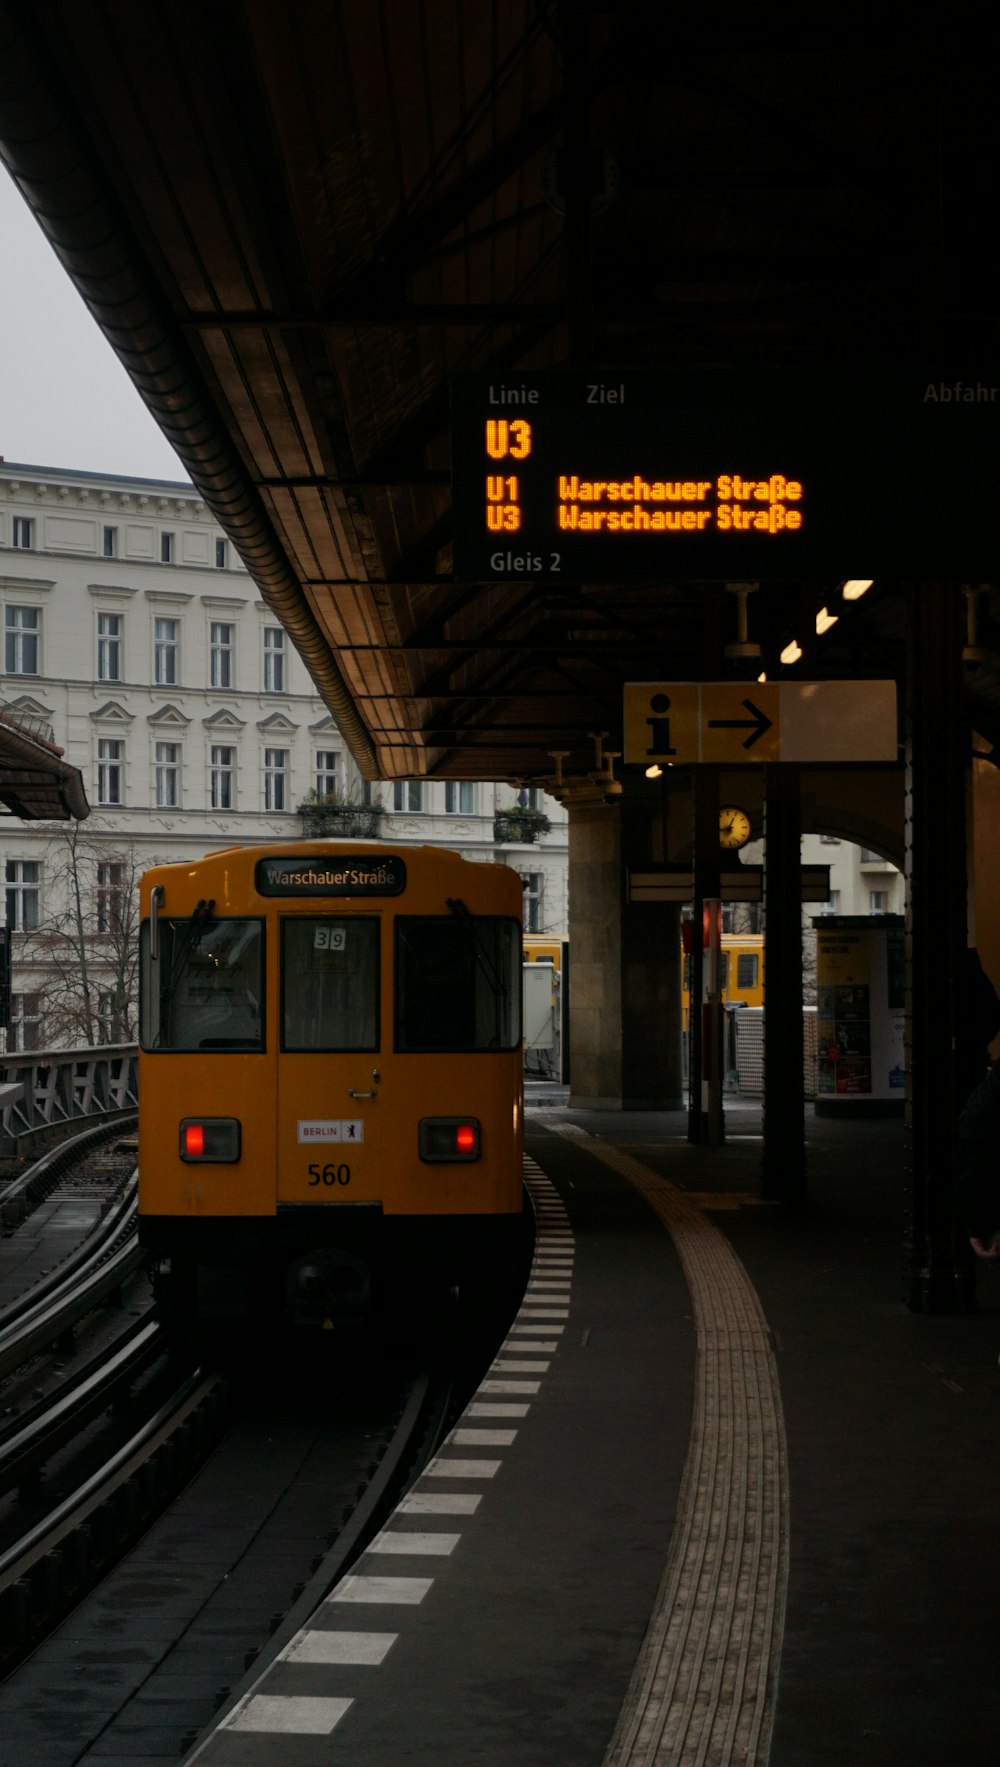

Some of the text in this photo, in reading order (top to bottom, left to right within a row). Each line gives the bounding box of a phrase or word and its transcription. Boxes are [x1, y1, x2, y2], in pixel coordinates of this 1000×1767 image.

[488, 384, 540, 405] Linie
[585, 383, 626, 404] Ziel
[485, 418, 533, 460] U3
[485, 474, 803, 504] U1 Warschauer Straße
[485, 504, 803, 534] U3 Warschauer Straße
[489, 551, 561, 572] Gleis 2
[266, 868, 395, 886] Warschauer Straße
[303, 1127, 337, 1136] BERLIN
[308, 1163, 350, 1186] 560
